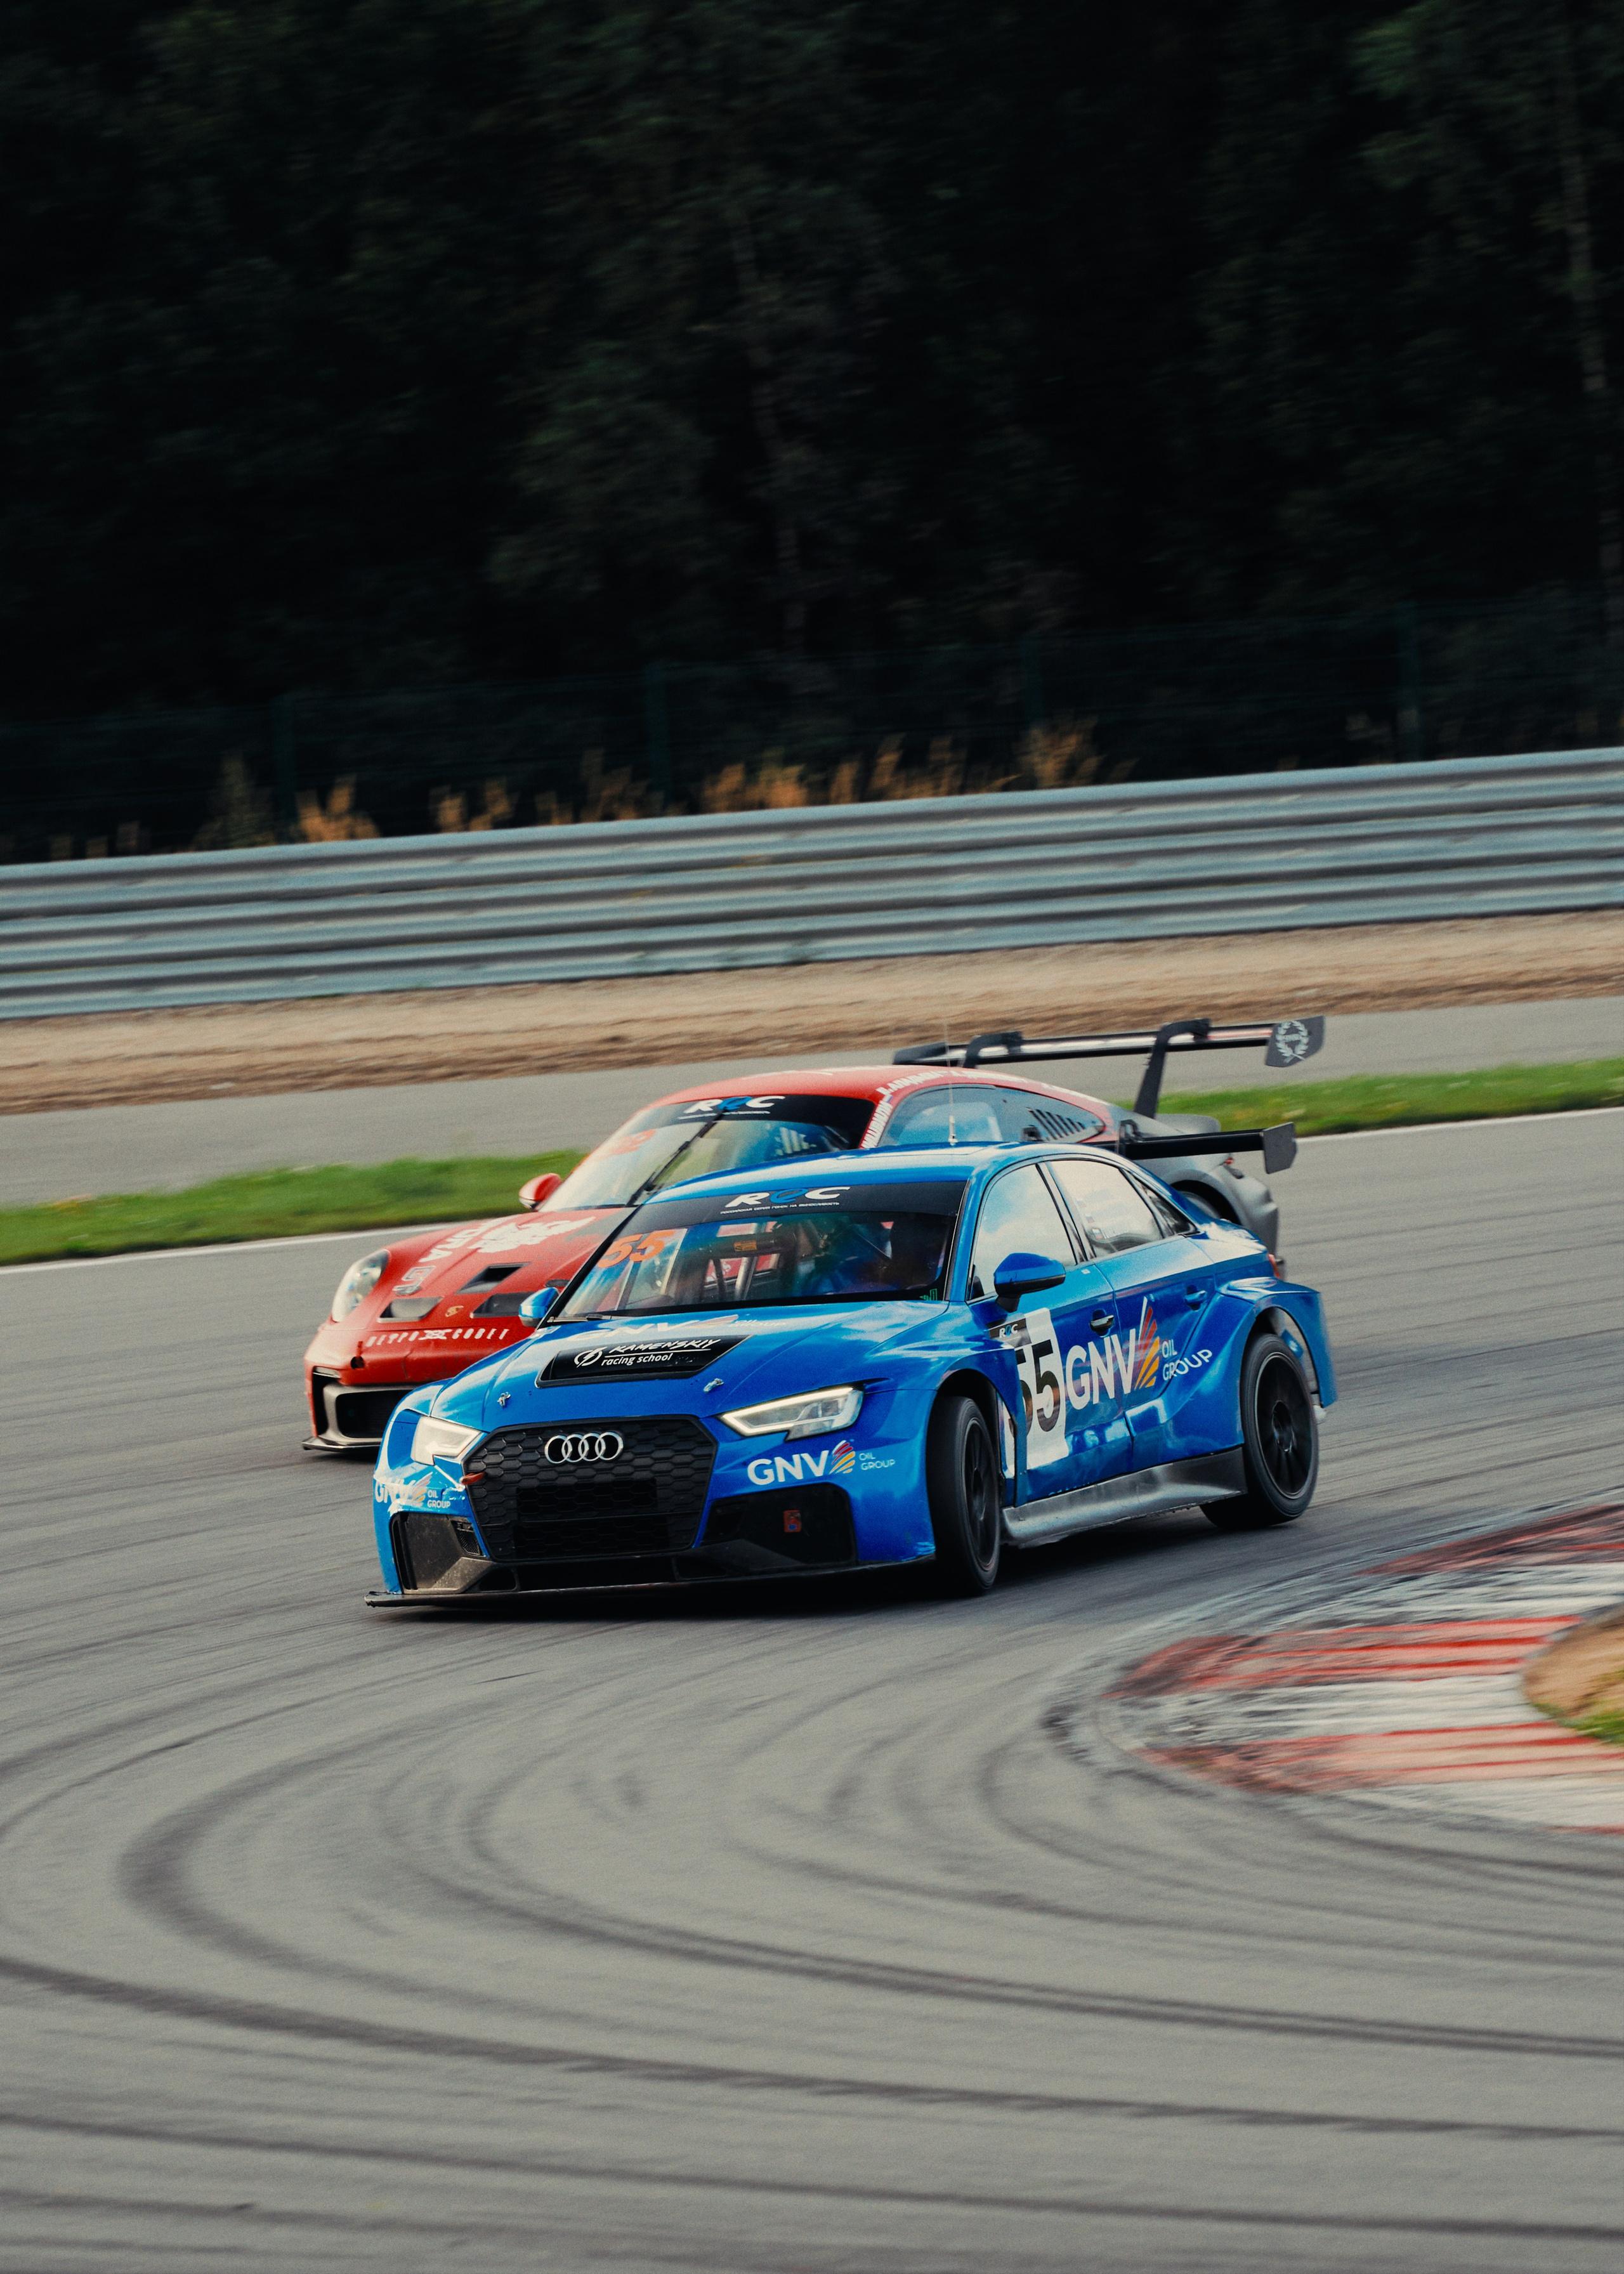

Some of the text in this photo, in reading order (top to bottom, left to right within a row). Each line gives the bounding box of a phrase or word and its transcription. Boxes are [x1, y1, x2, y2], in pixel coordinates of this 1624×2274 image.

[596, 1230, 675, 1268] 55
[609, 1339, 721, 1354] KAMENSKIY
[1162, 1339, 1177, 1358] OIL
[601, 1352, 673, 1366] racing school
[1163, 1349, 1213, 1381] GROUP
[1066, 1328, 1137, 1409] GNV
[747, 1450, 829, 1485] GNV
[861, 1459, 895, 1470] GROUP
[428, 1490, 438, 1498] OIL
[427, 1500, 451, 1508] GROUP
